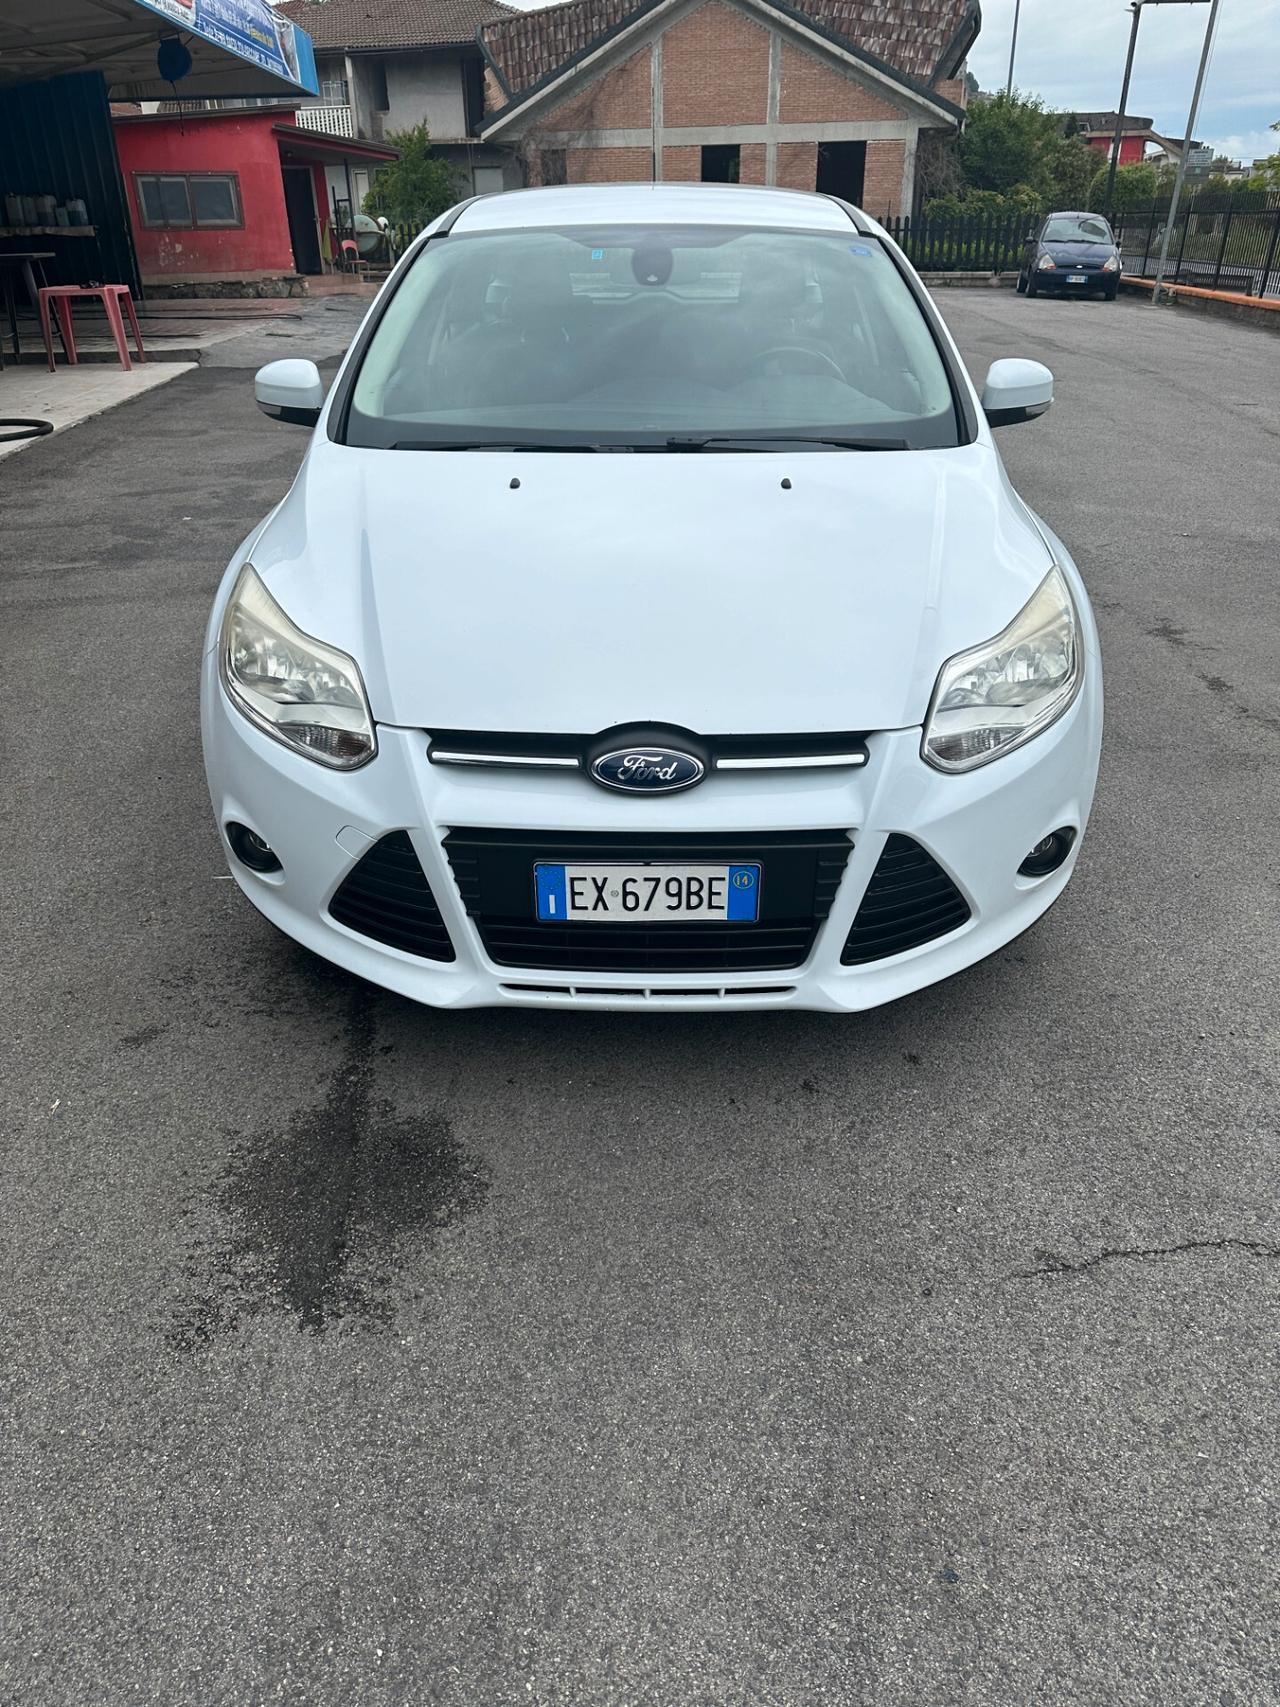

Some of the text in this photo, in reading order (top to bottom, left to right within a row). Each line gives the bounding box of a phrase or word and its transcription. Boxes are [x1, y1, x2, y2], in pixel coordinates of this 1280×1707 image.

[617, 755, 678, 780] Ford
[569, 876, 726, 911] EX 679BE
